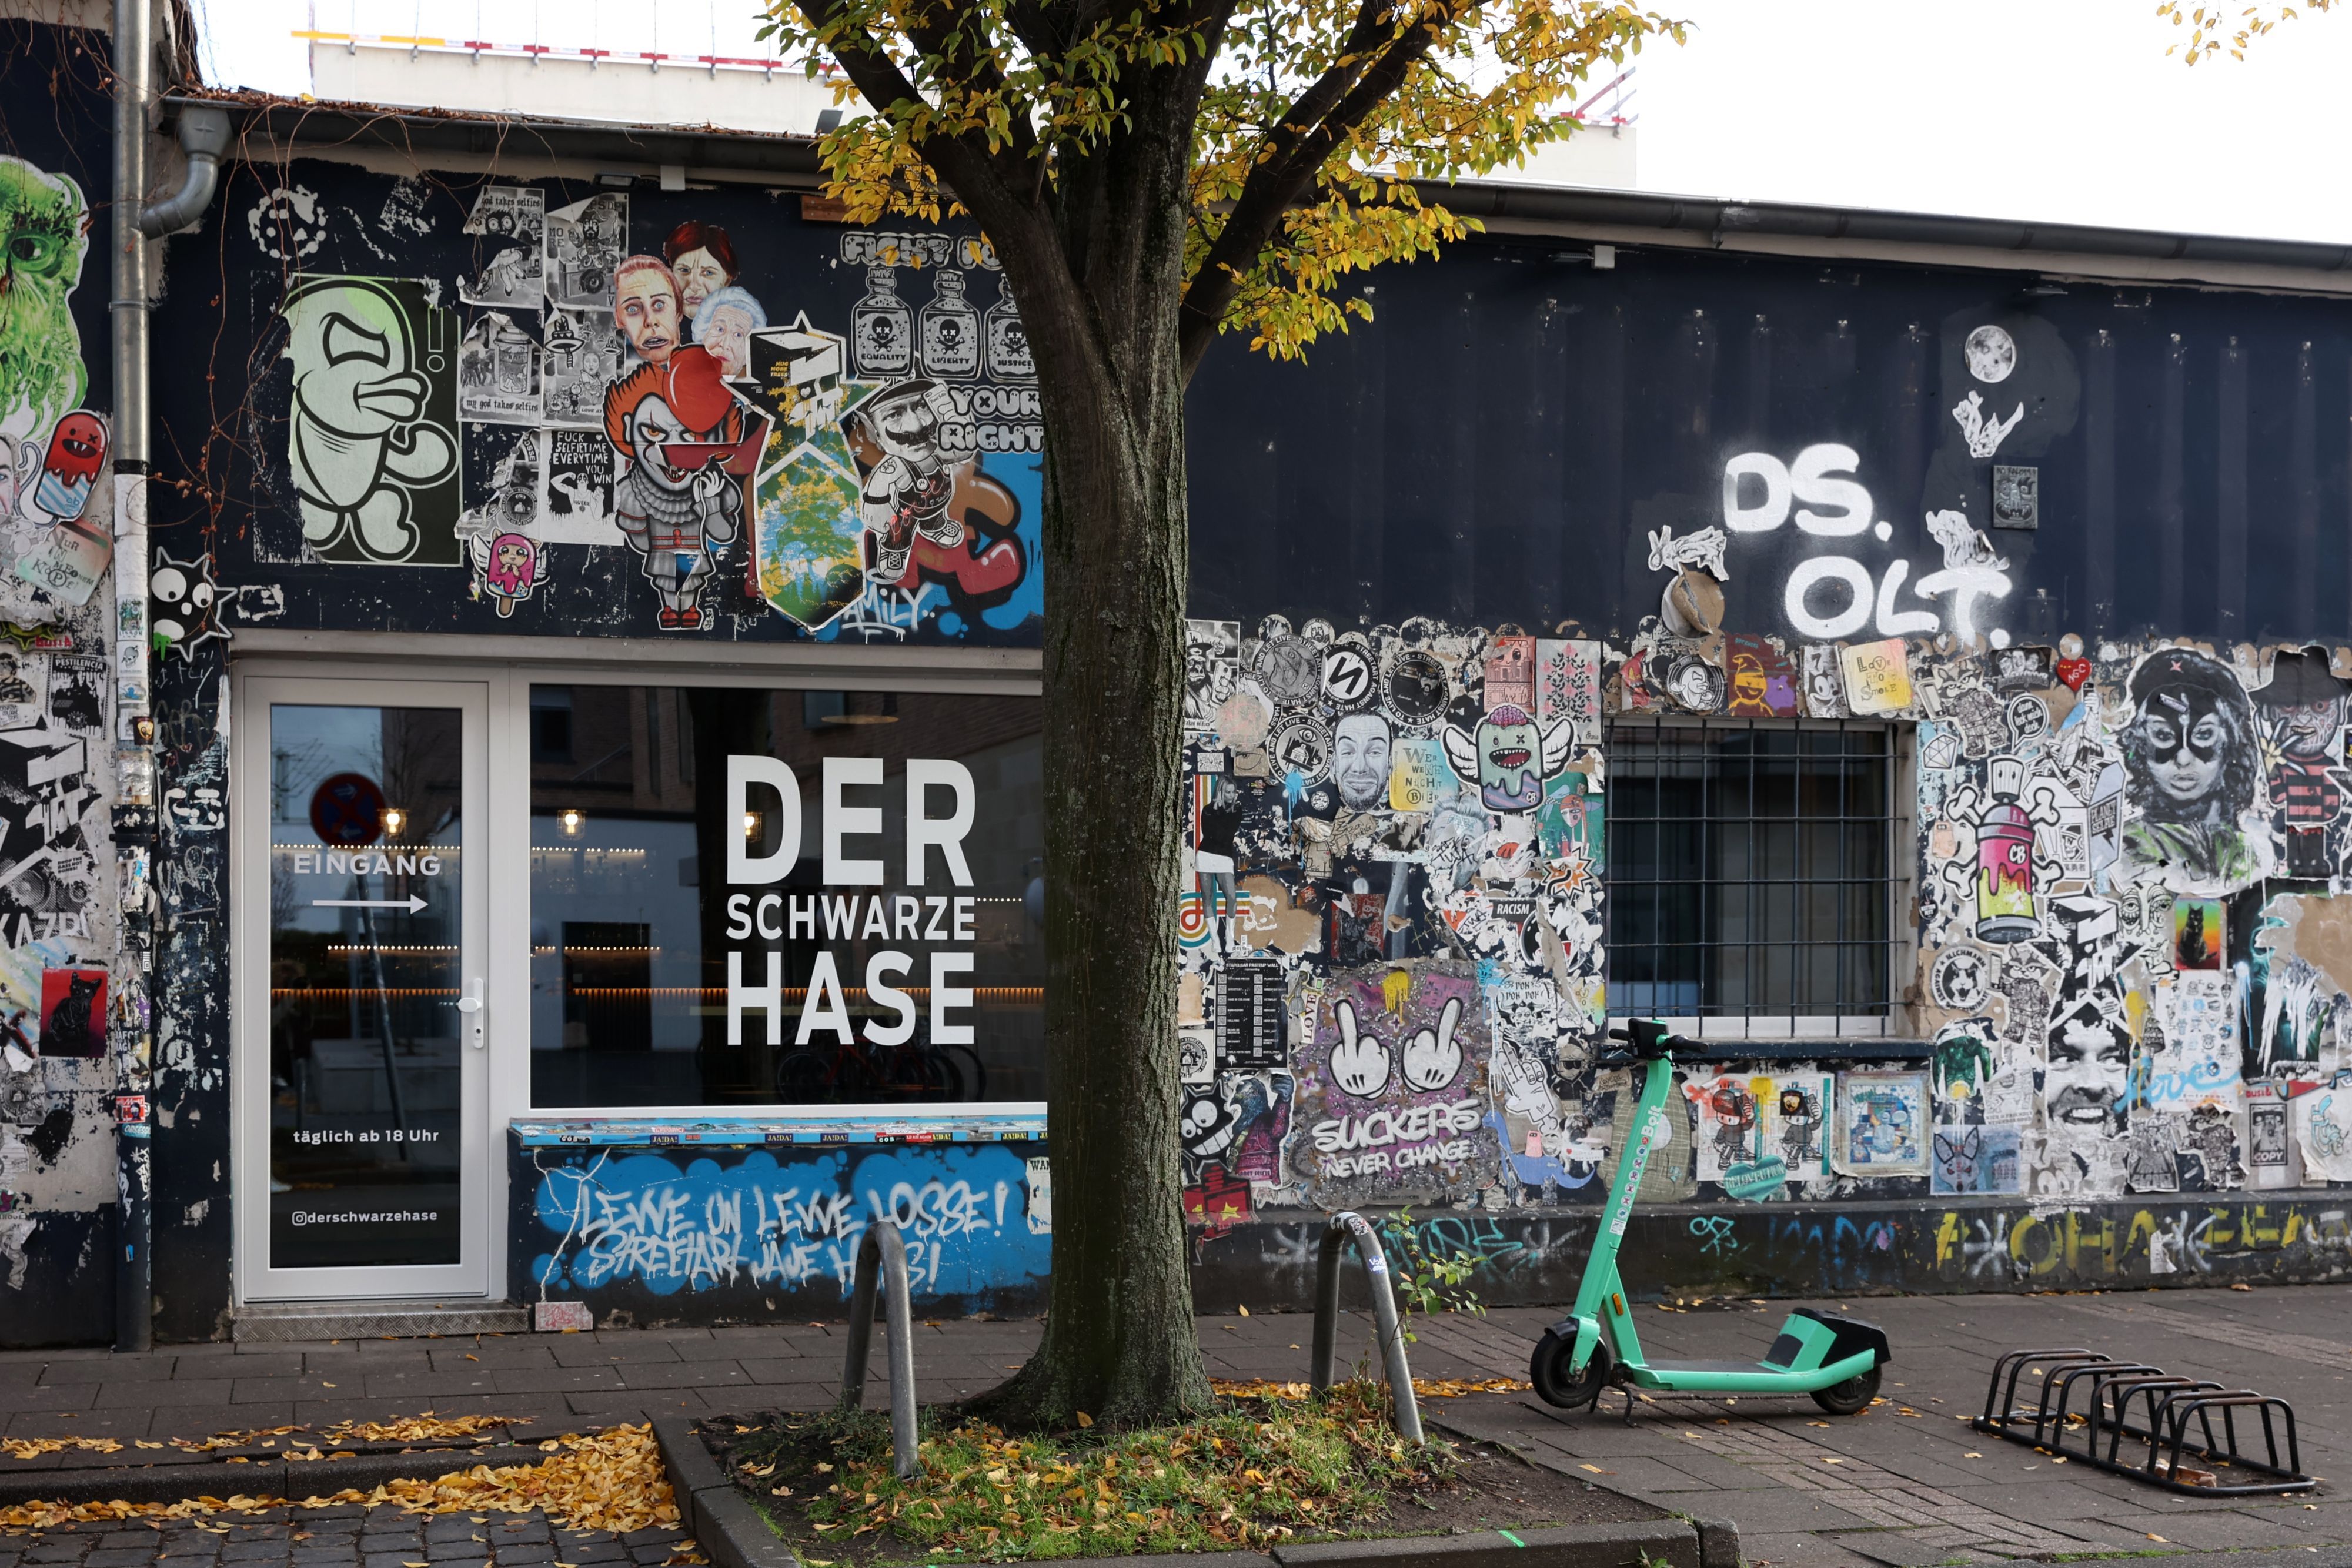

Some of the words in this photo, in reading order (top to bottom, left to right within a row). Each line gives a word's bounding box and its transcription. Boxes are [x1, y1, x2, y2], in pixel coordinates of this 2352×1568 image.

[493, 400, 513, 409] takes
[515, 402, 539, 411] selfies
[557, 432, 584, 442] FUCK
[553, 453, 609, 464] EVERYTIME
[586, 465, 604, 474] YOU
[594, 474, 612, 484] WIN
[1263, 641, 1274, 651] LET
[1298, 637, 1322, 671] STREETART
[1395, 654, 1411, 666] LIVE
[55, 657, 103, 670] PESTILENCIA
[1355, 644, 1378, 680] STREETART
[1417, 653, 1447, 683] STREETART
[1256, 669, 1265, 684] LIVE
[1385, 666, 1395, 677] LET
[1263, 687, 1272, 697] TO
[1385, 696, 1396, 712] LIVE
[1285, 717, 1301, 727] LIVE
[1395, 711, 1405, 721] TO
[1274, 726, 1284, 737] LET
[1307, 718, 1333, 750] STREETART
[1270, 754, 1279, 772] LIVE
[727, 754, 976, 887] DER
[294, 854, 440, 875] EINGANG
[726, 893, 975, 940] SCHWARZE
[1497, 904, 1530, 914] RACISM
[727, 950, 974, 1046] HASE
[1303, 994, 1317, 1040] LOVE
[1312, 1098, 1482, 1153] SUCKERS
[1641, 1105, 1662, 1137] Bolt
[293, 1129, 354, 1145] täglich
[359, 1129, 380, 1142] ab
[385, 1129, 403, 1142] 18
[409, 1129, 439, 1142] Uhr
[2253, 1151, 2283, 1161] COPY
[1325, 1152, 1392, 1179] NEVER
[308, 1210, 438, 1223] derschwarzehase
[706, 1190, 743, 1236] UN
